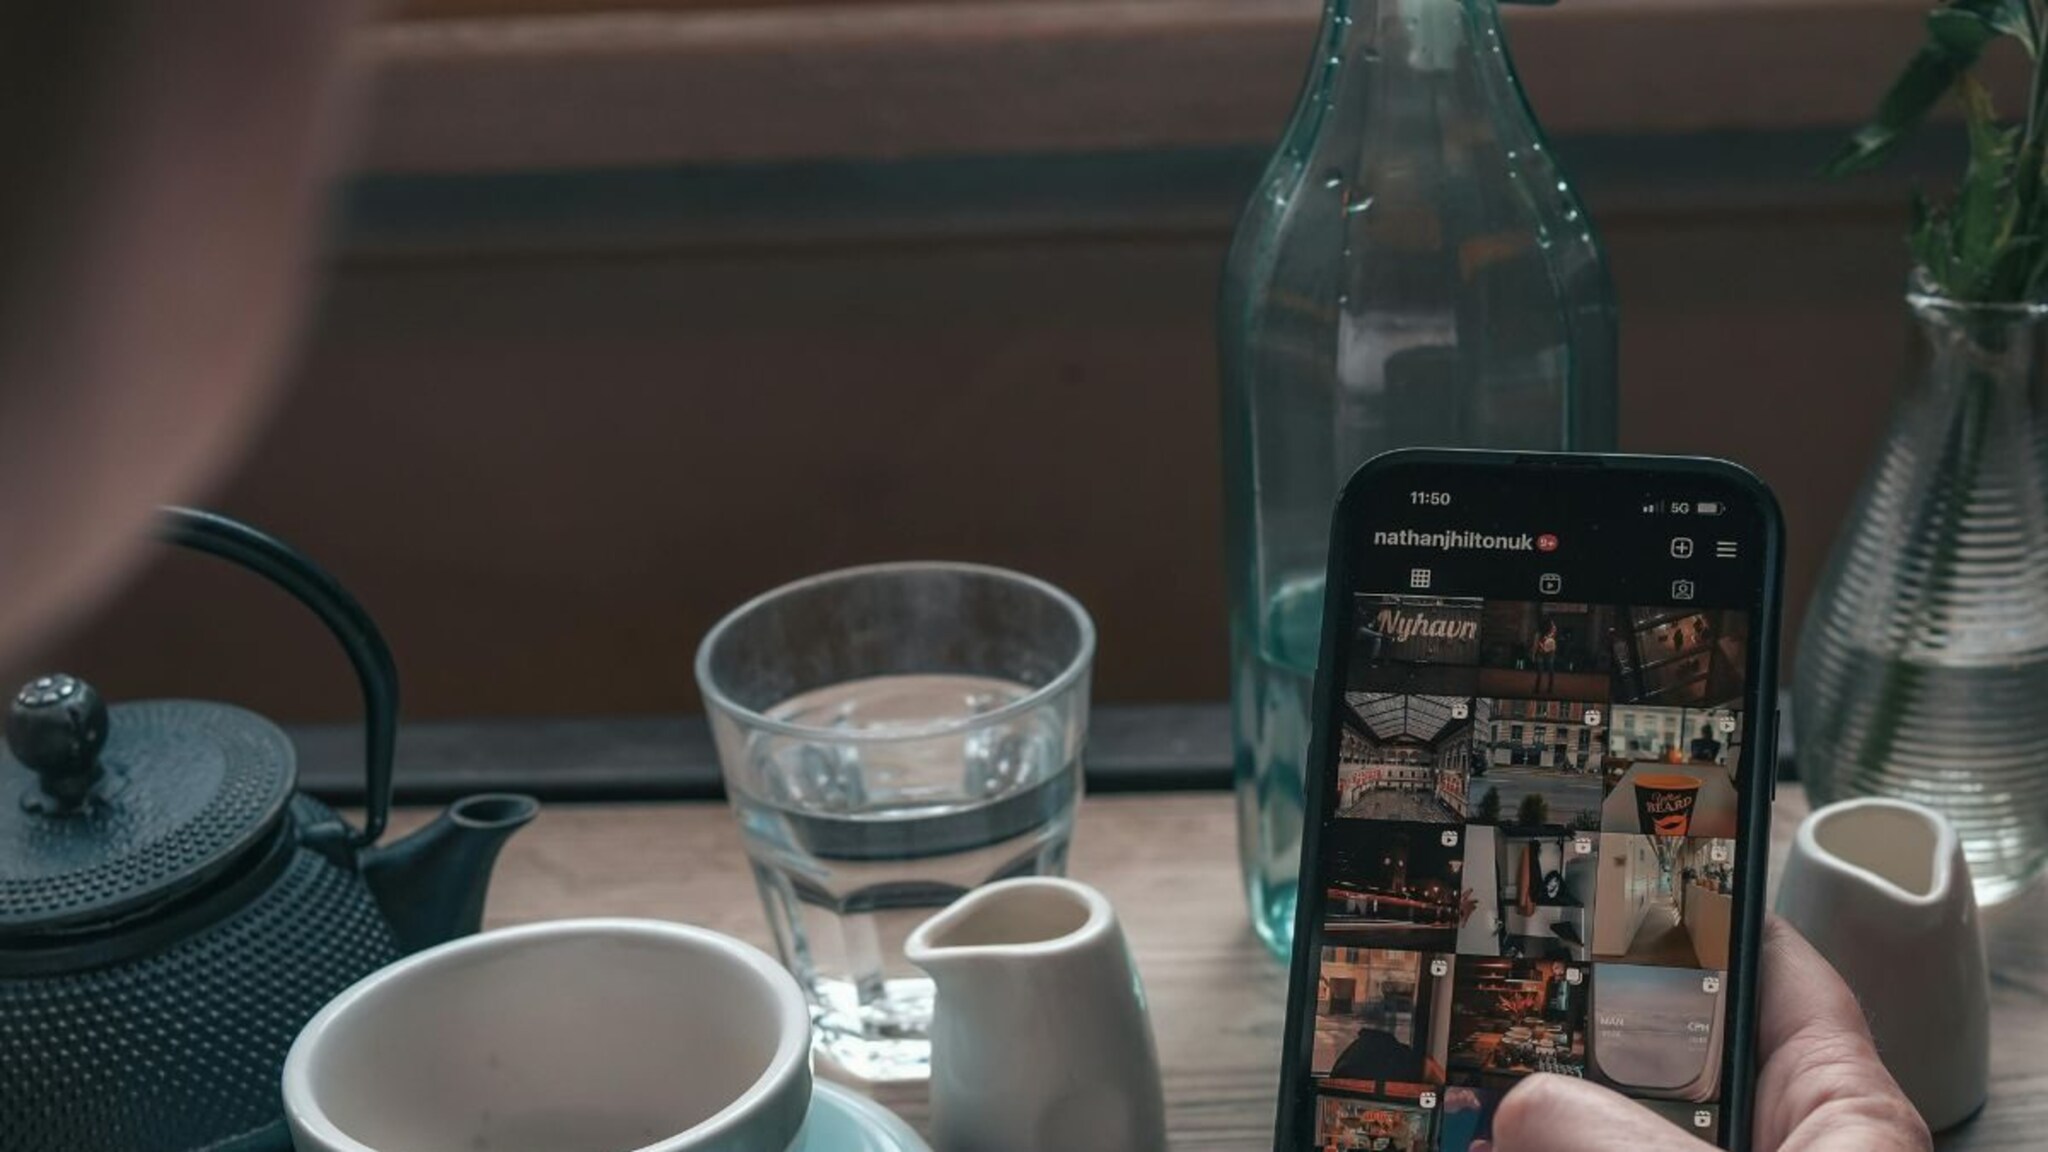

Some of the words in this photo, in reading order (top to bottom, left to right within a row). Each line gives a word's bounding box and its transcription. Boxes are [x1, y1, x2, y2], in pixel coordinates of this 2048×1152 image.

[1409, 491, 1451, 506] 11:50
[1671, 501, 1690, 514] 5G
[1373, 529, 1533, 551] nathanjhiltonuk
[1377, 608, 1478, 642] Nyhavn
